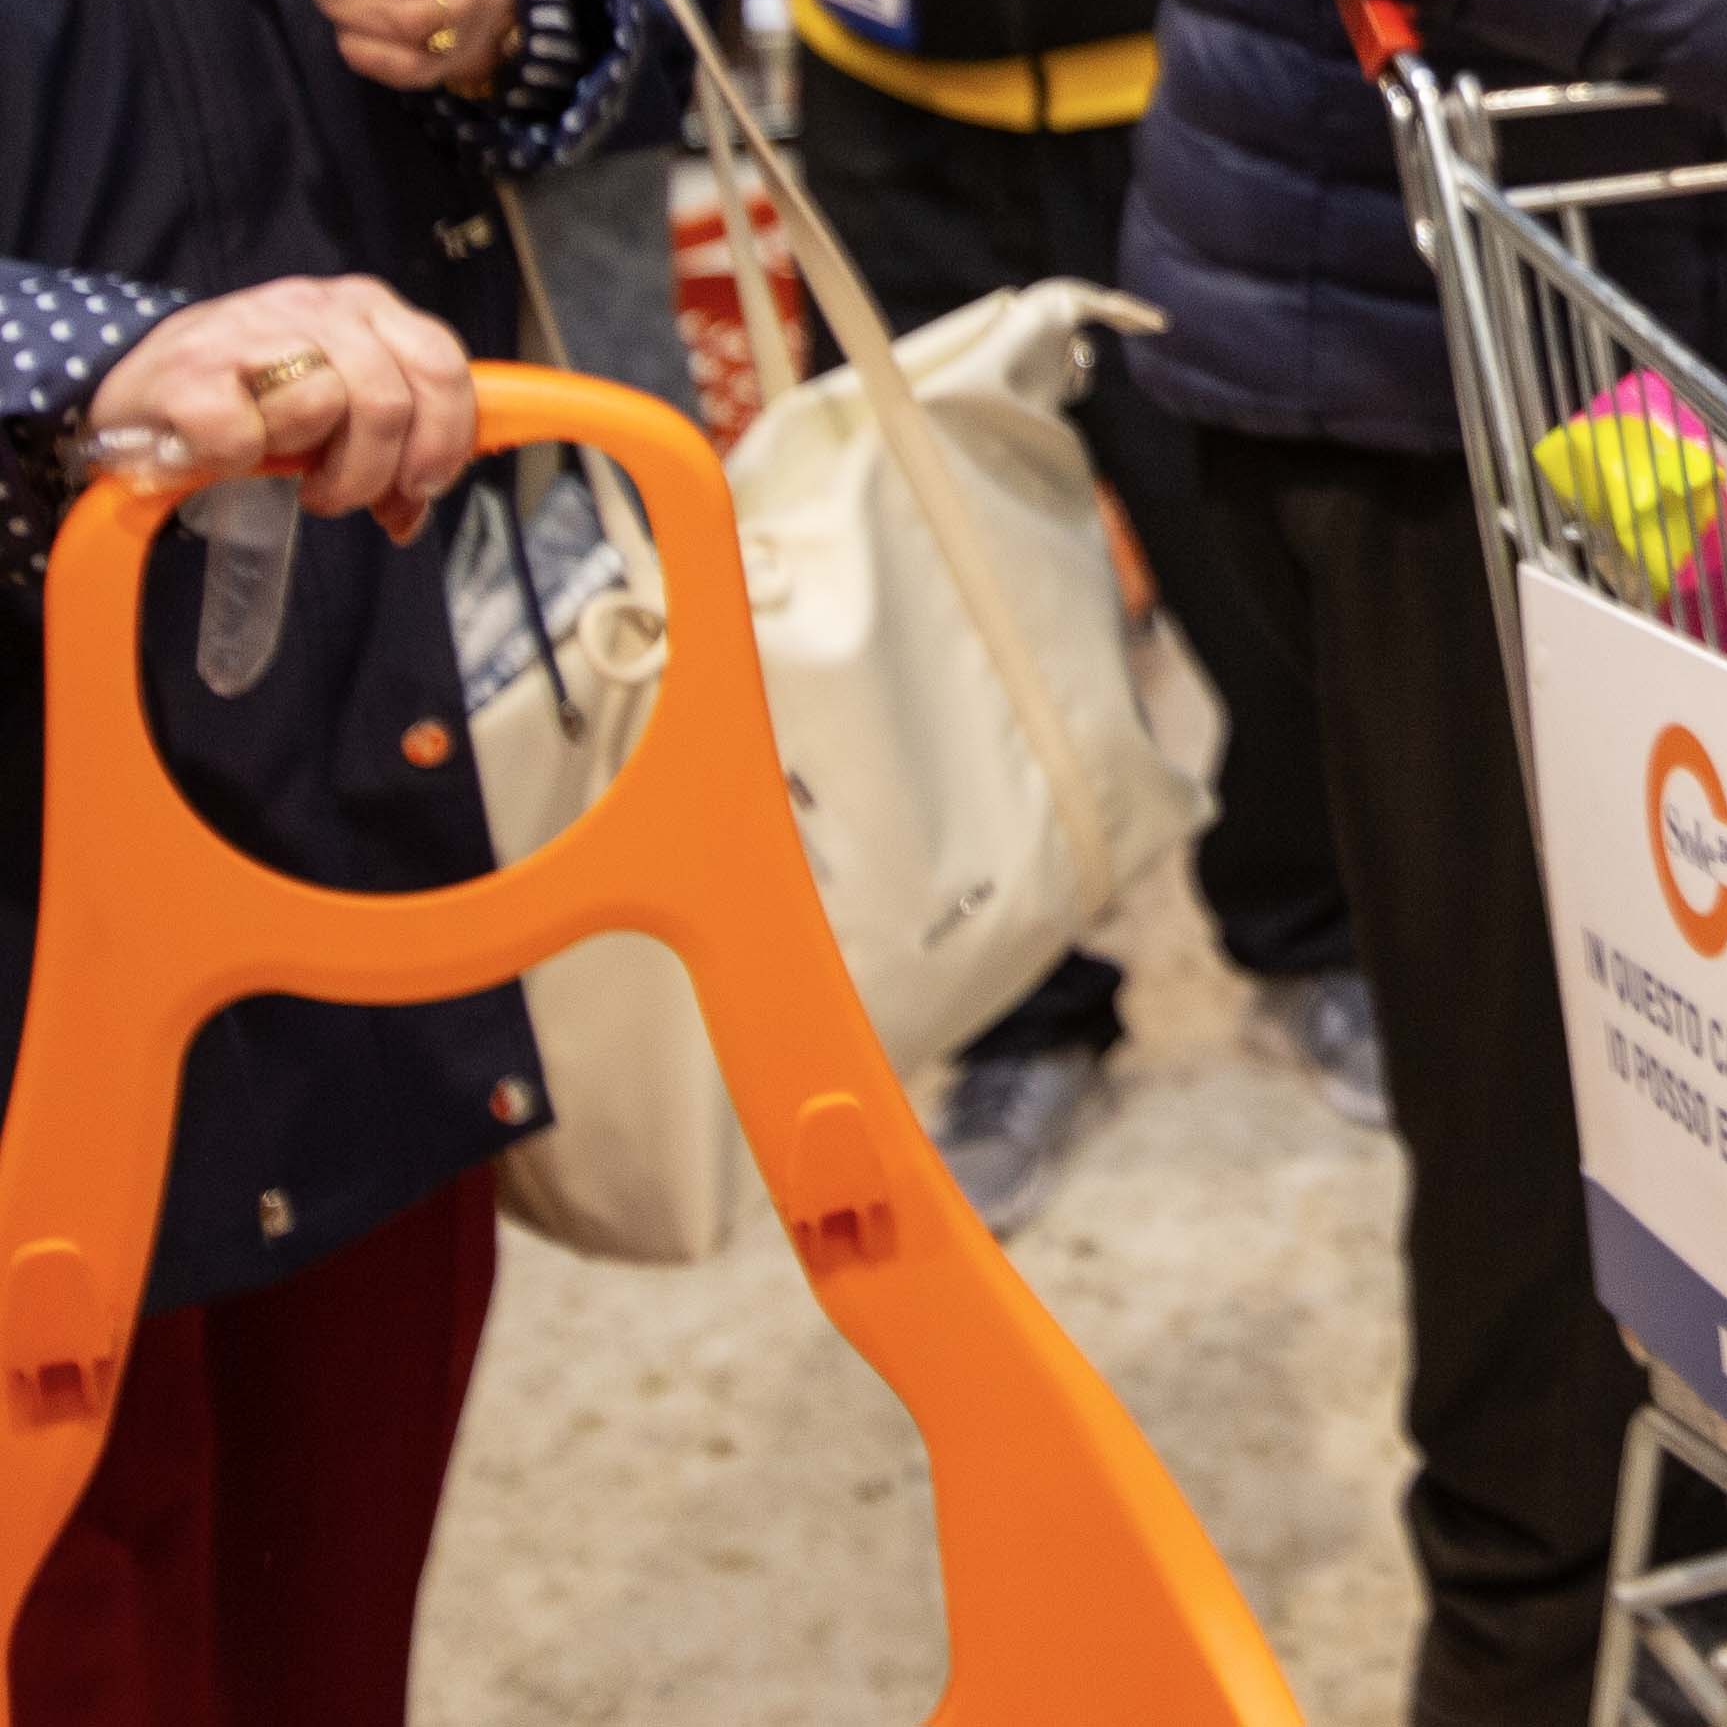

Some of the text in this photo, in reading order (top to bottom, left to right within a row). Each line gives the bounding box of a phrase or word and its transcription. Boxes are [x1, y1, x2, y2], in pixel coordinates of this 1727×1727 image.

[1583, 924, 1608, 990] IN
[1611, 949, 1704, 1060] QUESTO
[1632, 1042, 1712, 1148] POSSO
